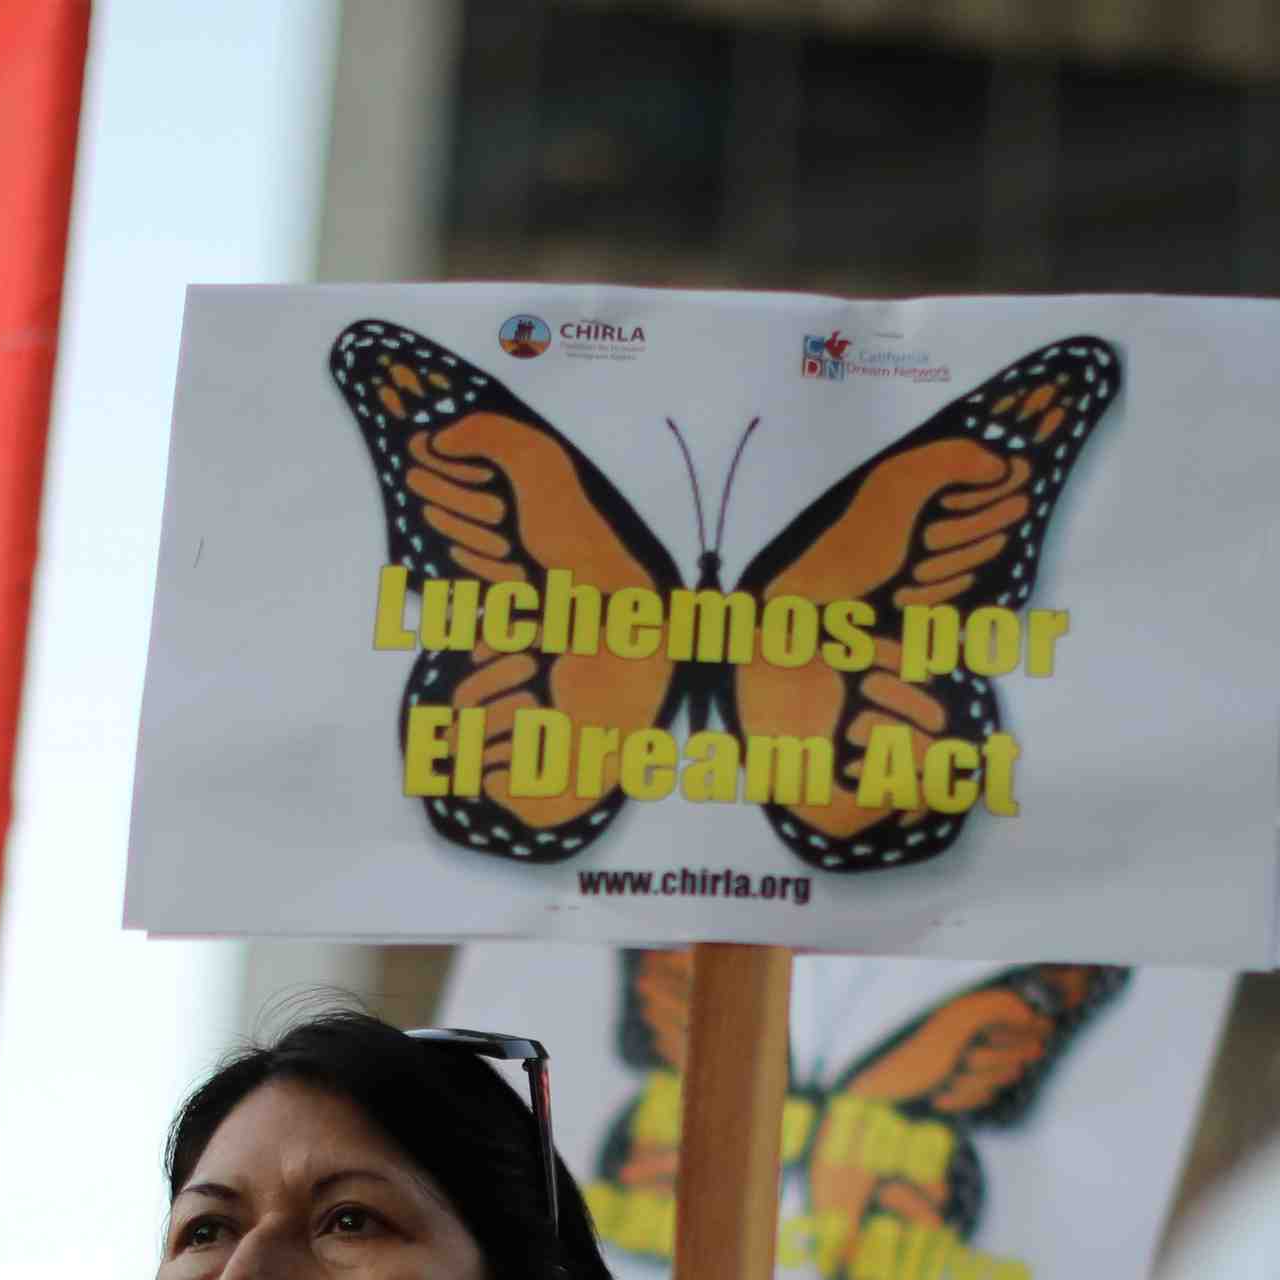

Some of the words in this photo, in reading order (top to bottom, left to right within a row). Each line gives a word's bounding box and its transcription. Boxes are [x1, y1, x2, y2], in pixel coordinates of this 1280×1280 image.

[559, 322, 646, 342] CHIRLA
[372, 565, 875, 671] Luchemos
[899, 601, 1069, 683] por
[402, 706, 486, 798] El
[508, 708, 835, 806] Dream
[855, 724, 1021, 818] Act
[577, 867, 813, 906] www.chirla.org
